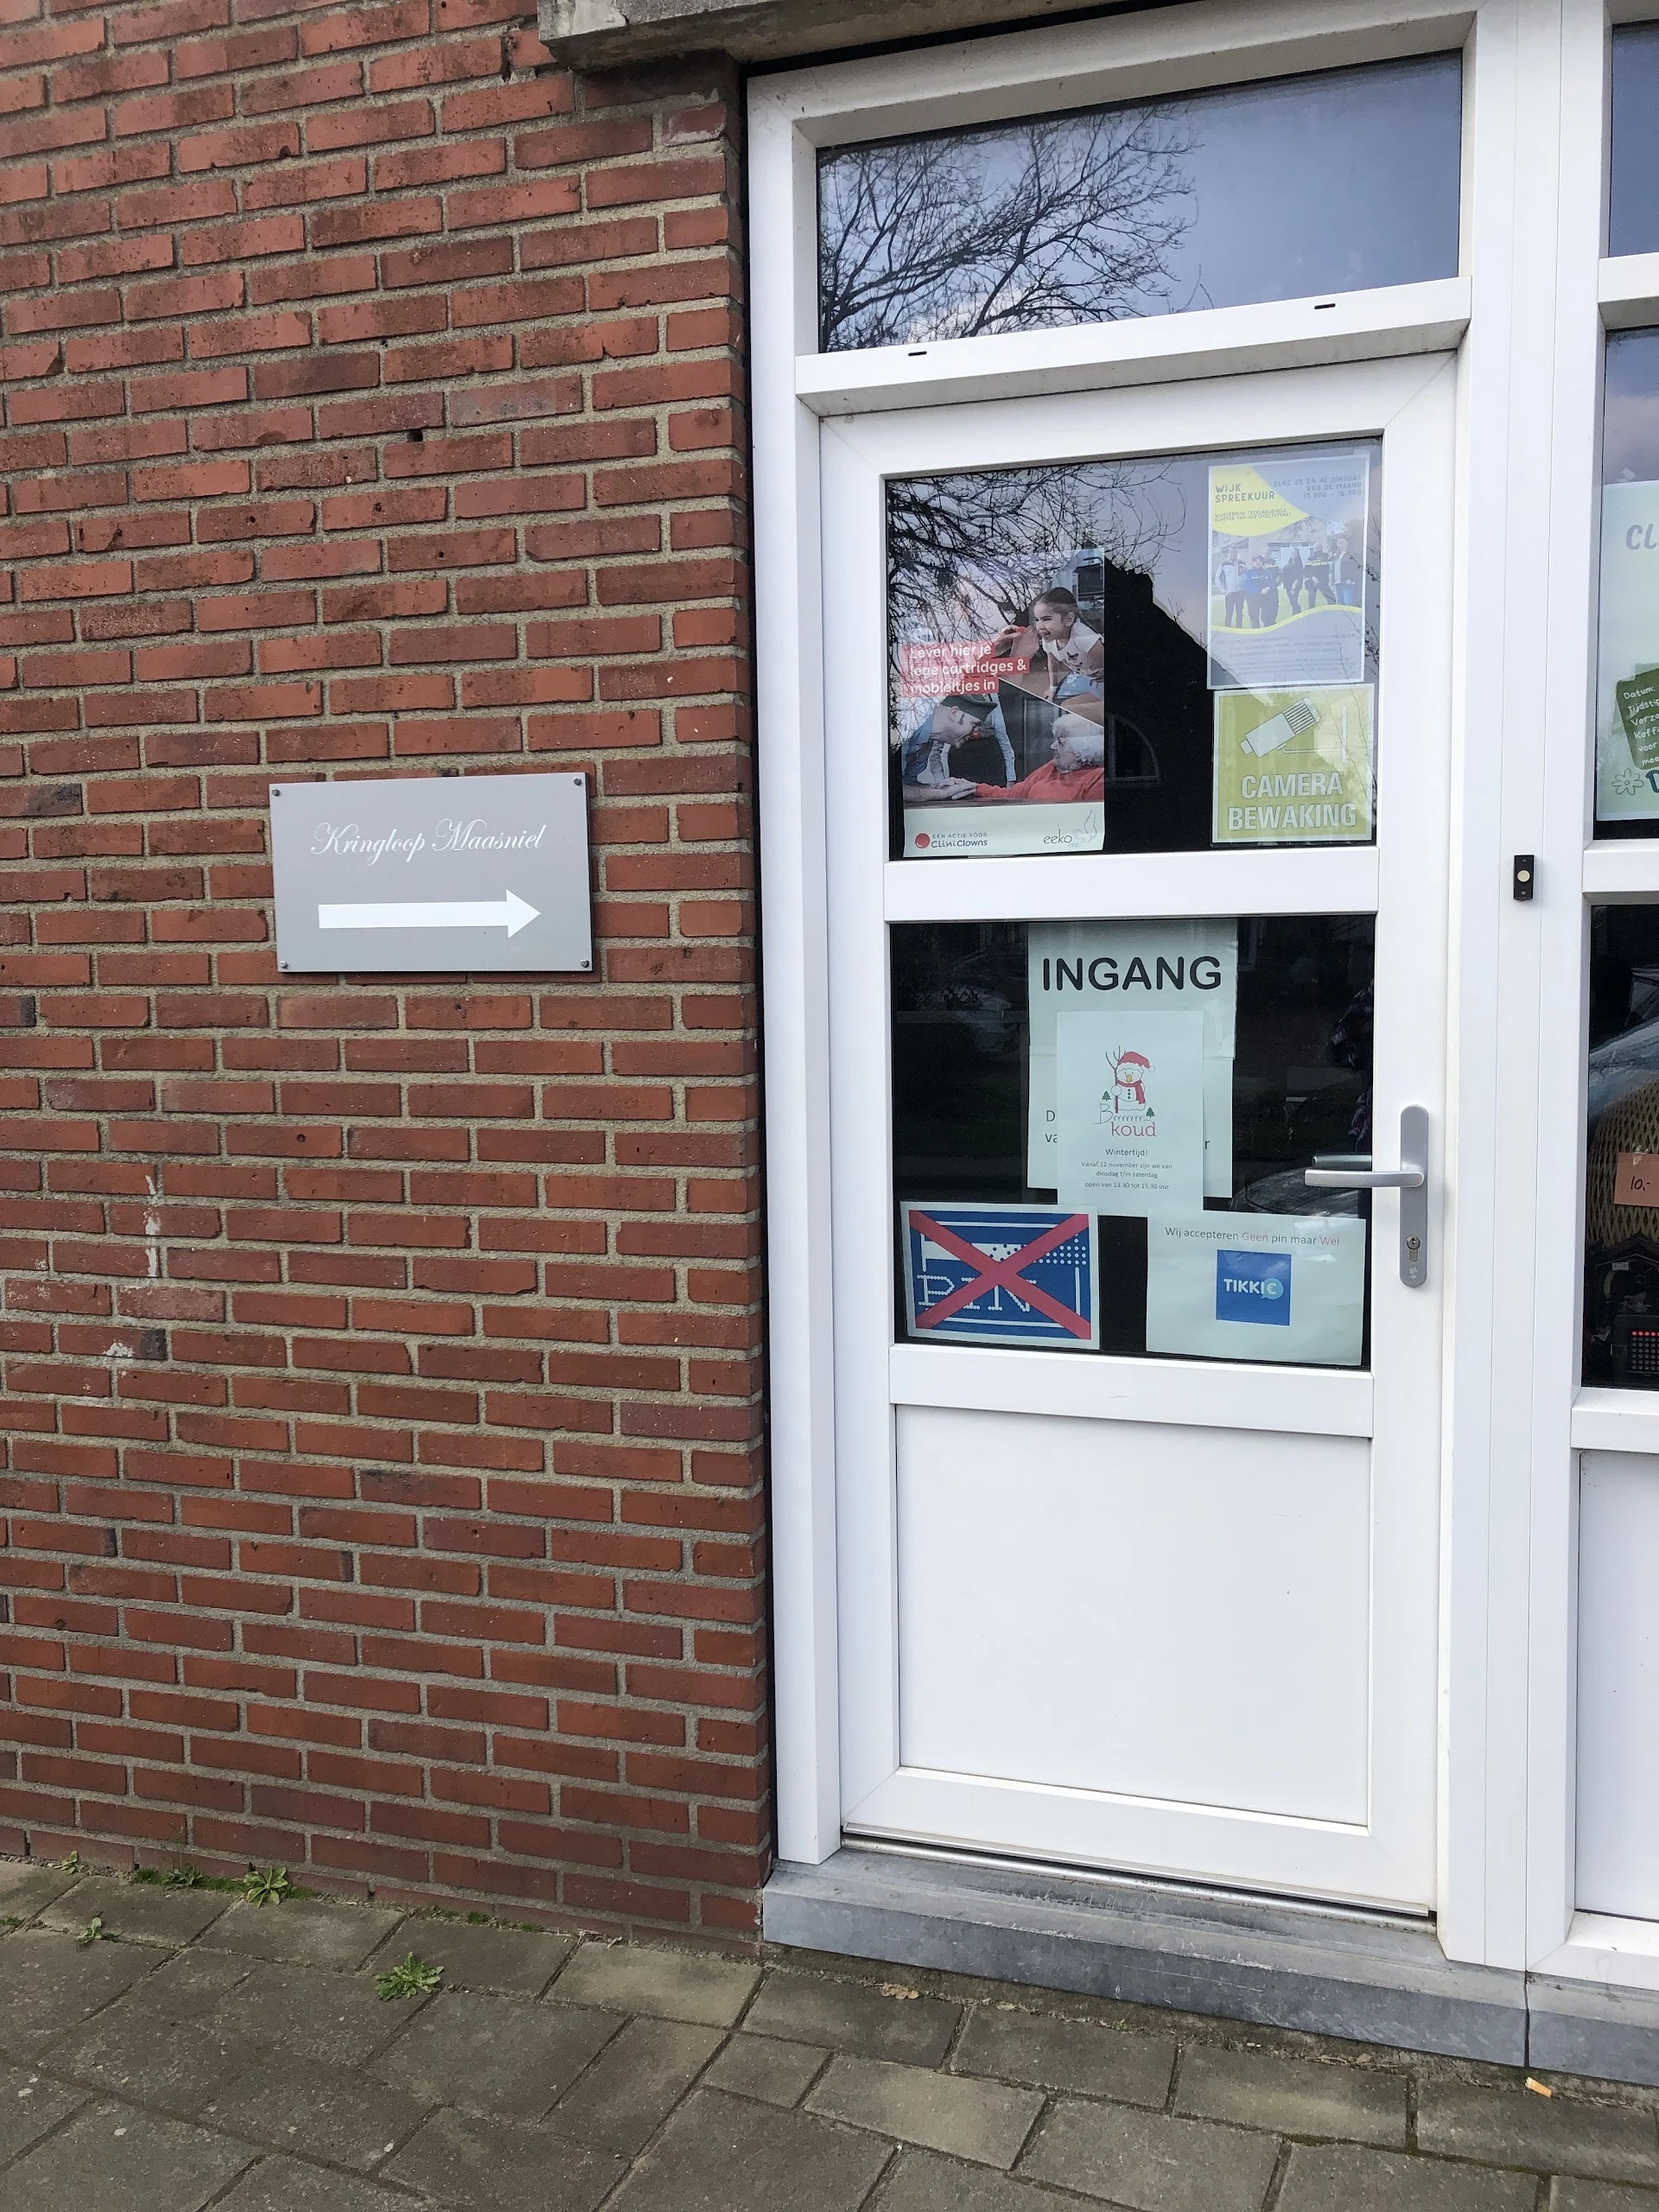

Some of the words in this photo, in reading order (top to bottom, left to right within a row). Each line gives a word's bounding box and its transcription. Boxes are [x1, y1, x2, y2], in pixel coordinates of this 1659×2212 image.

[1215, 483, 1242, 493] WIJK
[1336, 481, 1362, 490] MAAND
[1215, 491, 1275, 503] SPREEKUUR
[910, 646, 947, 659] Lever
[950, 643, 976, 657] hier
[979, 643, 992, 658] je
[942, 660, 1014, 675] cartridges
[1016, 658, 1027, 671] &
[911, 681, 981, 696] mobieltjes
[983, 678, 995, 690] in
[1624, 686, 1656, 700] Datum:
[1638, 741, 1657, 753] voor
[1241, 772, 1344, 800] CAMERA
[1228, 803, 1357, 831] BEWAKING
[310, 822, 426, 867] Kringloop
[431, 818, 547, 852] Maasniel
[1043, 828, 1072, 844] eeko
[1043, 956, 1222, 991] INGANG
[1110, 1122, 1157, 1137] koud
[1105, 1148, 1148, 1158] Wintertijd!
[1166, 1228, 1182, 1238] Wij
[1185, 1230, 1239, 1242] accepteren
[1242, 1233, 1268, 1242] Geen
[1271, 1236, 1287, 1244] pin
[1320, 1236, 1339, 1246] Wel
